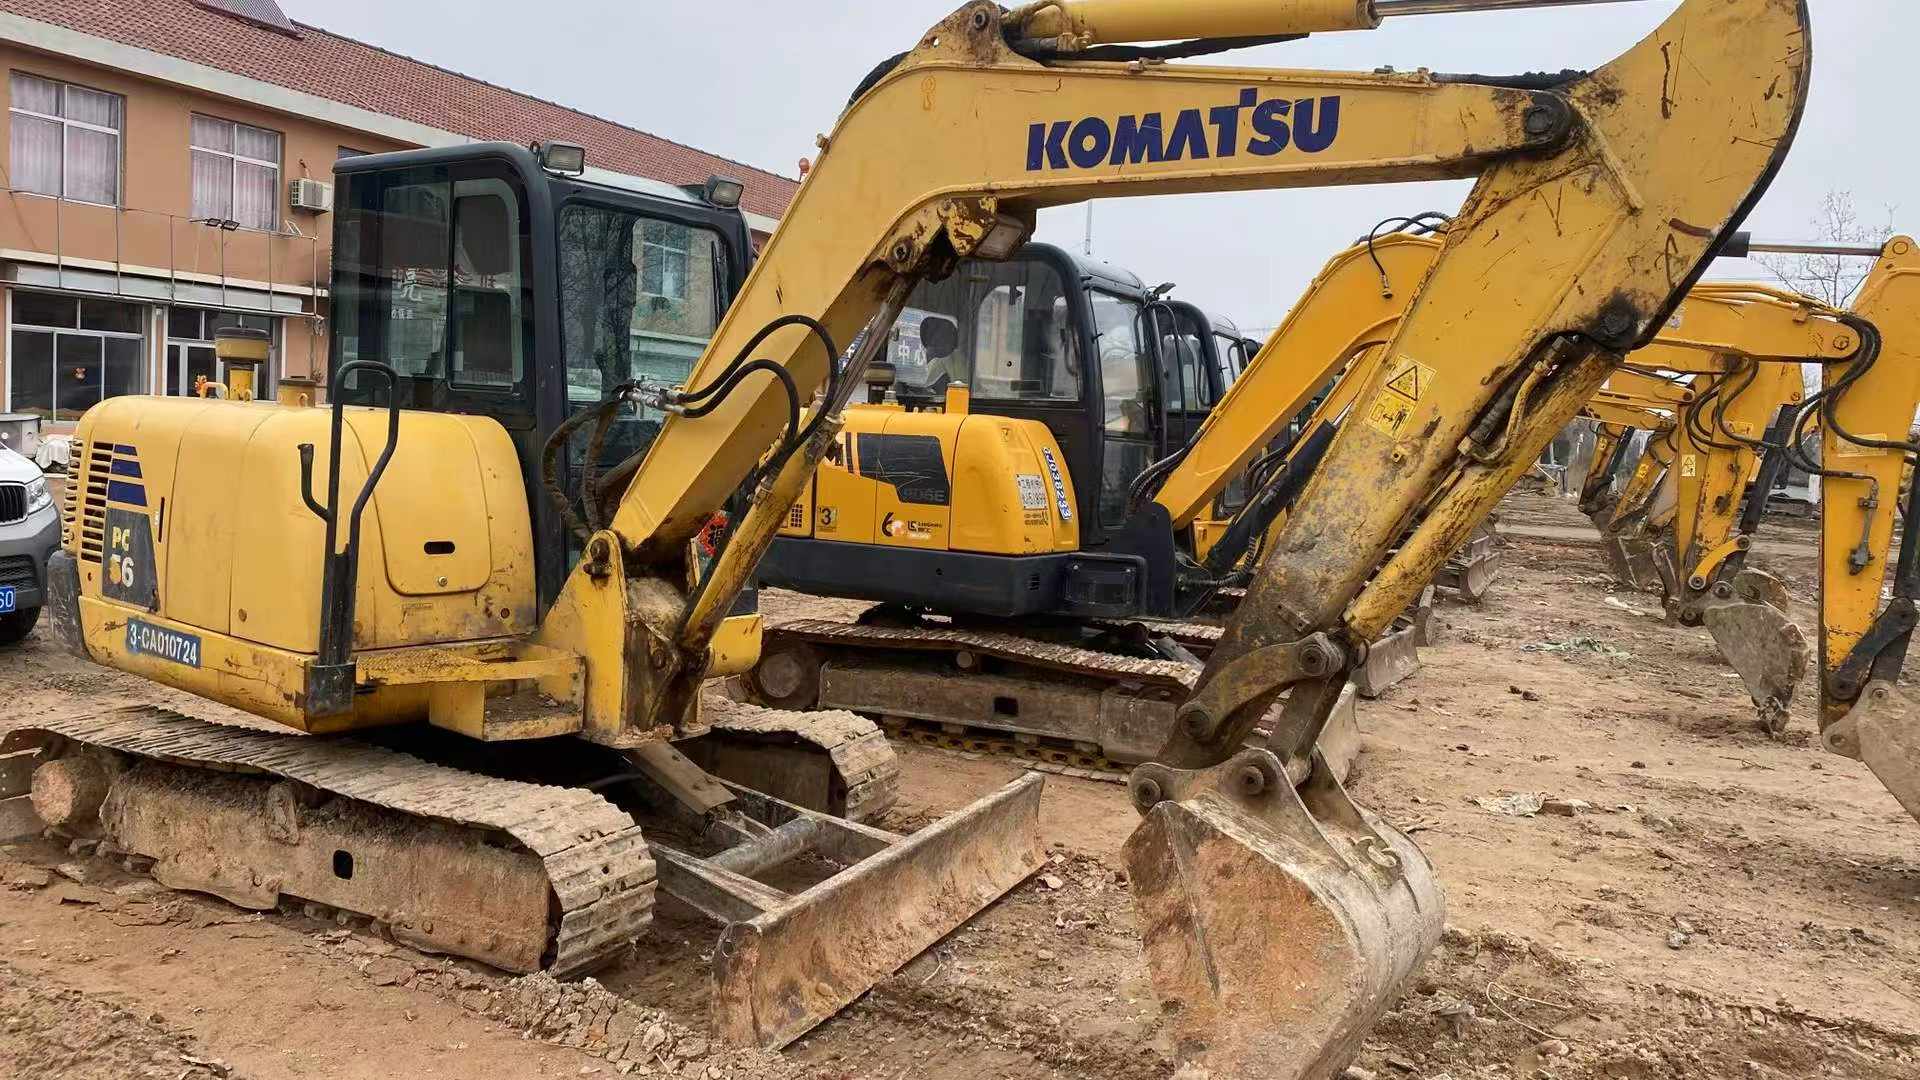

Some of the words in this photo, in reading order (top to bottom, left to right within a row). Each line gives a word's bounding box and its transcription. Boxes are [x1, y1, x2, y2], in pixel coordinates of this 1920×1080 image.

[1026, 88, 1340, 171] KOMATSU
[112, 526, 131, 552] PC
[109, 554, 135, 588] 56
[130, 623, 197, 665] 3-CA010724
